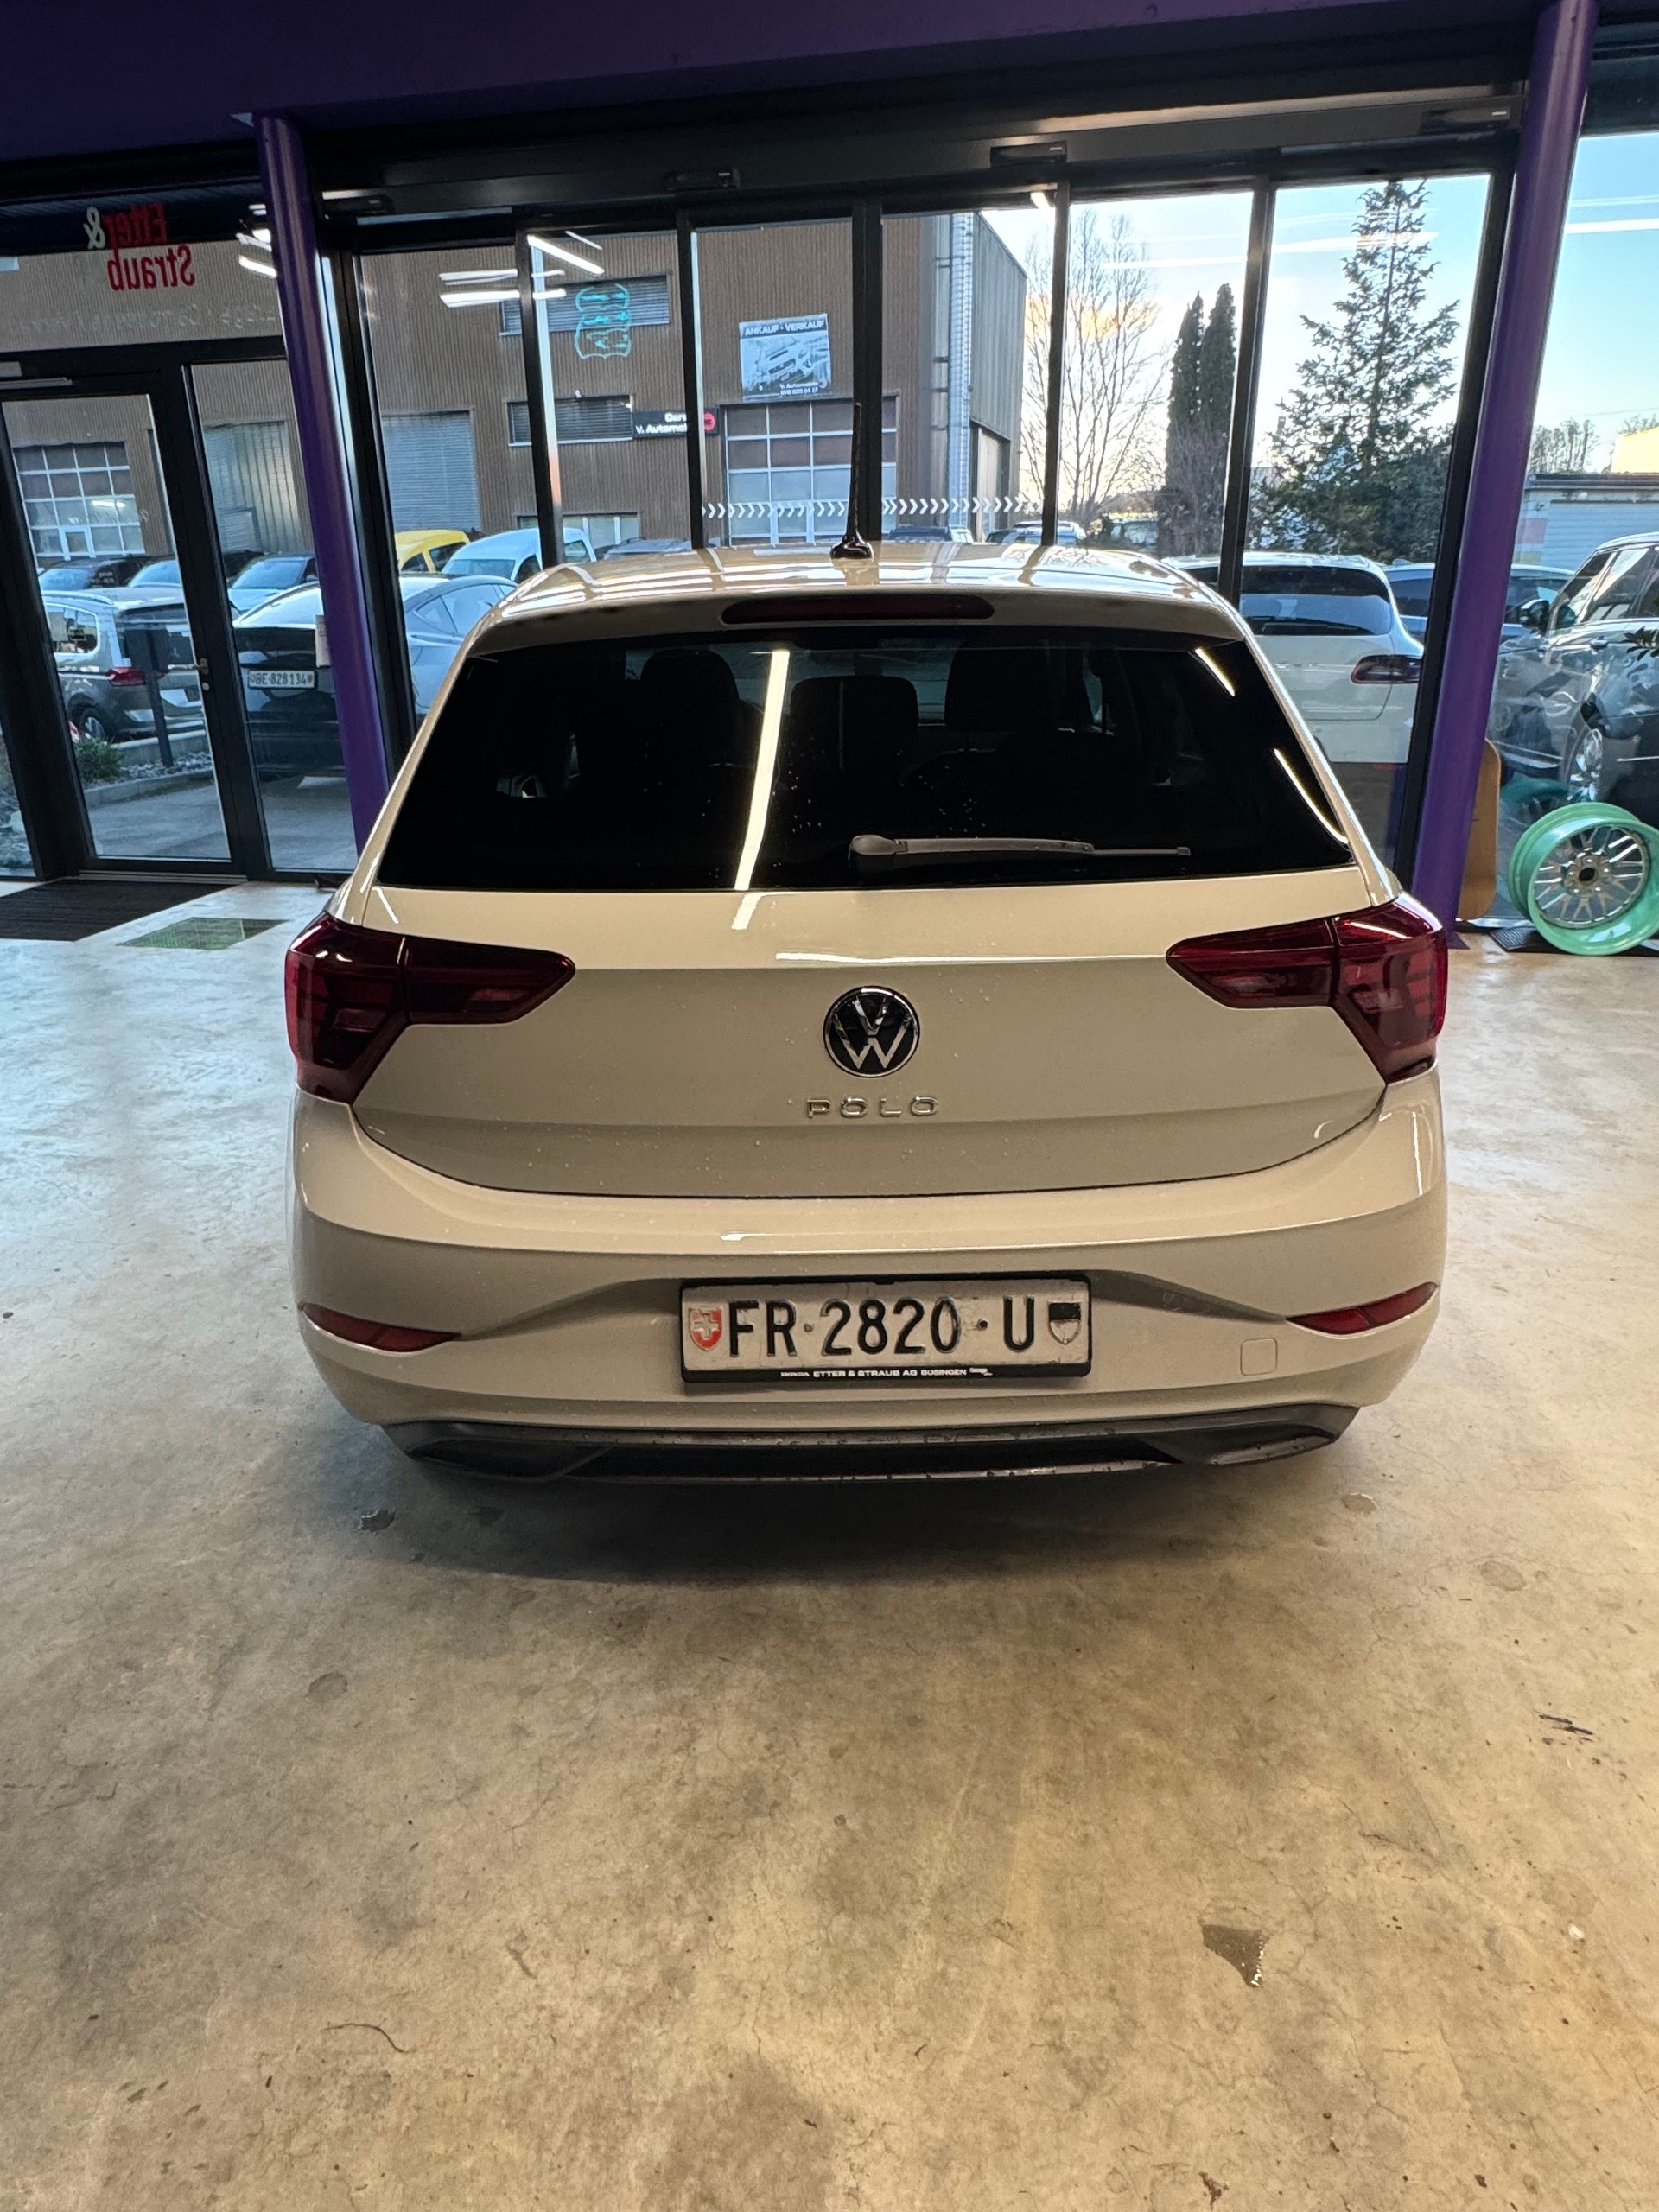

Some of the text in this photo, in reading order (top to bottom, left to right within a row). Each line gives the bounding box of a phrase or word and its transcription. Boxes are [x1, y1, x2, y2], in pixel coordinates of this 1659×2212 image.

[745, 320, 825, 336] ANKAUF VERKAUF
[806, 1096, 938, 1119] POLO
[1002, 1294, 1035, 1353] U
